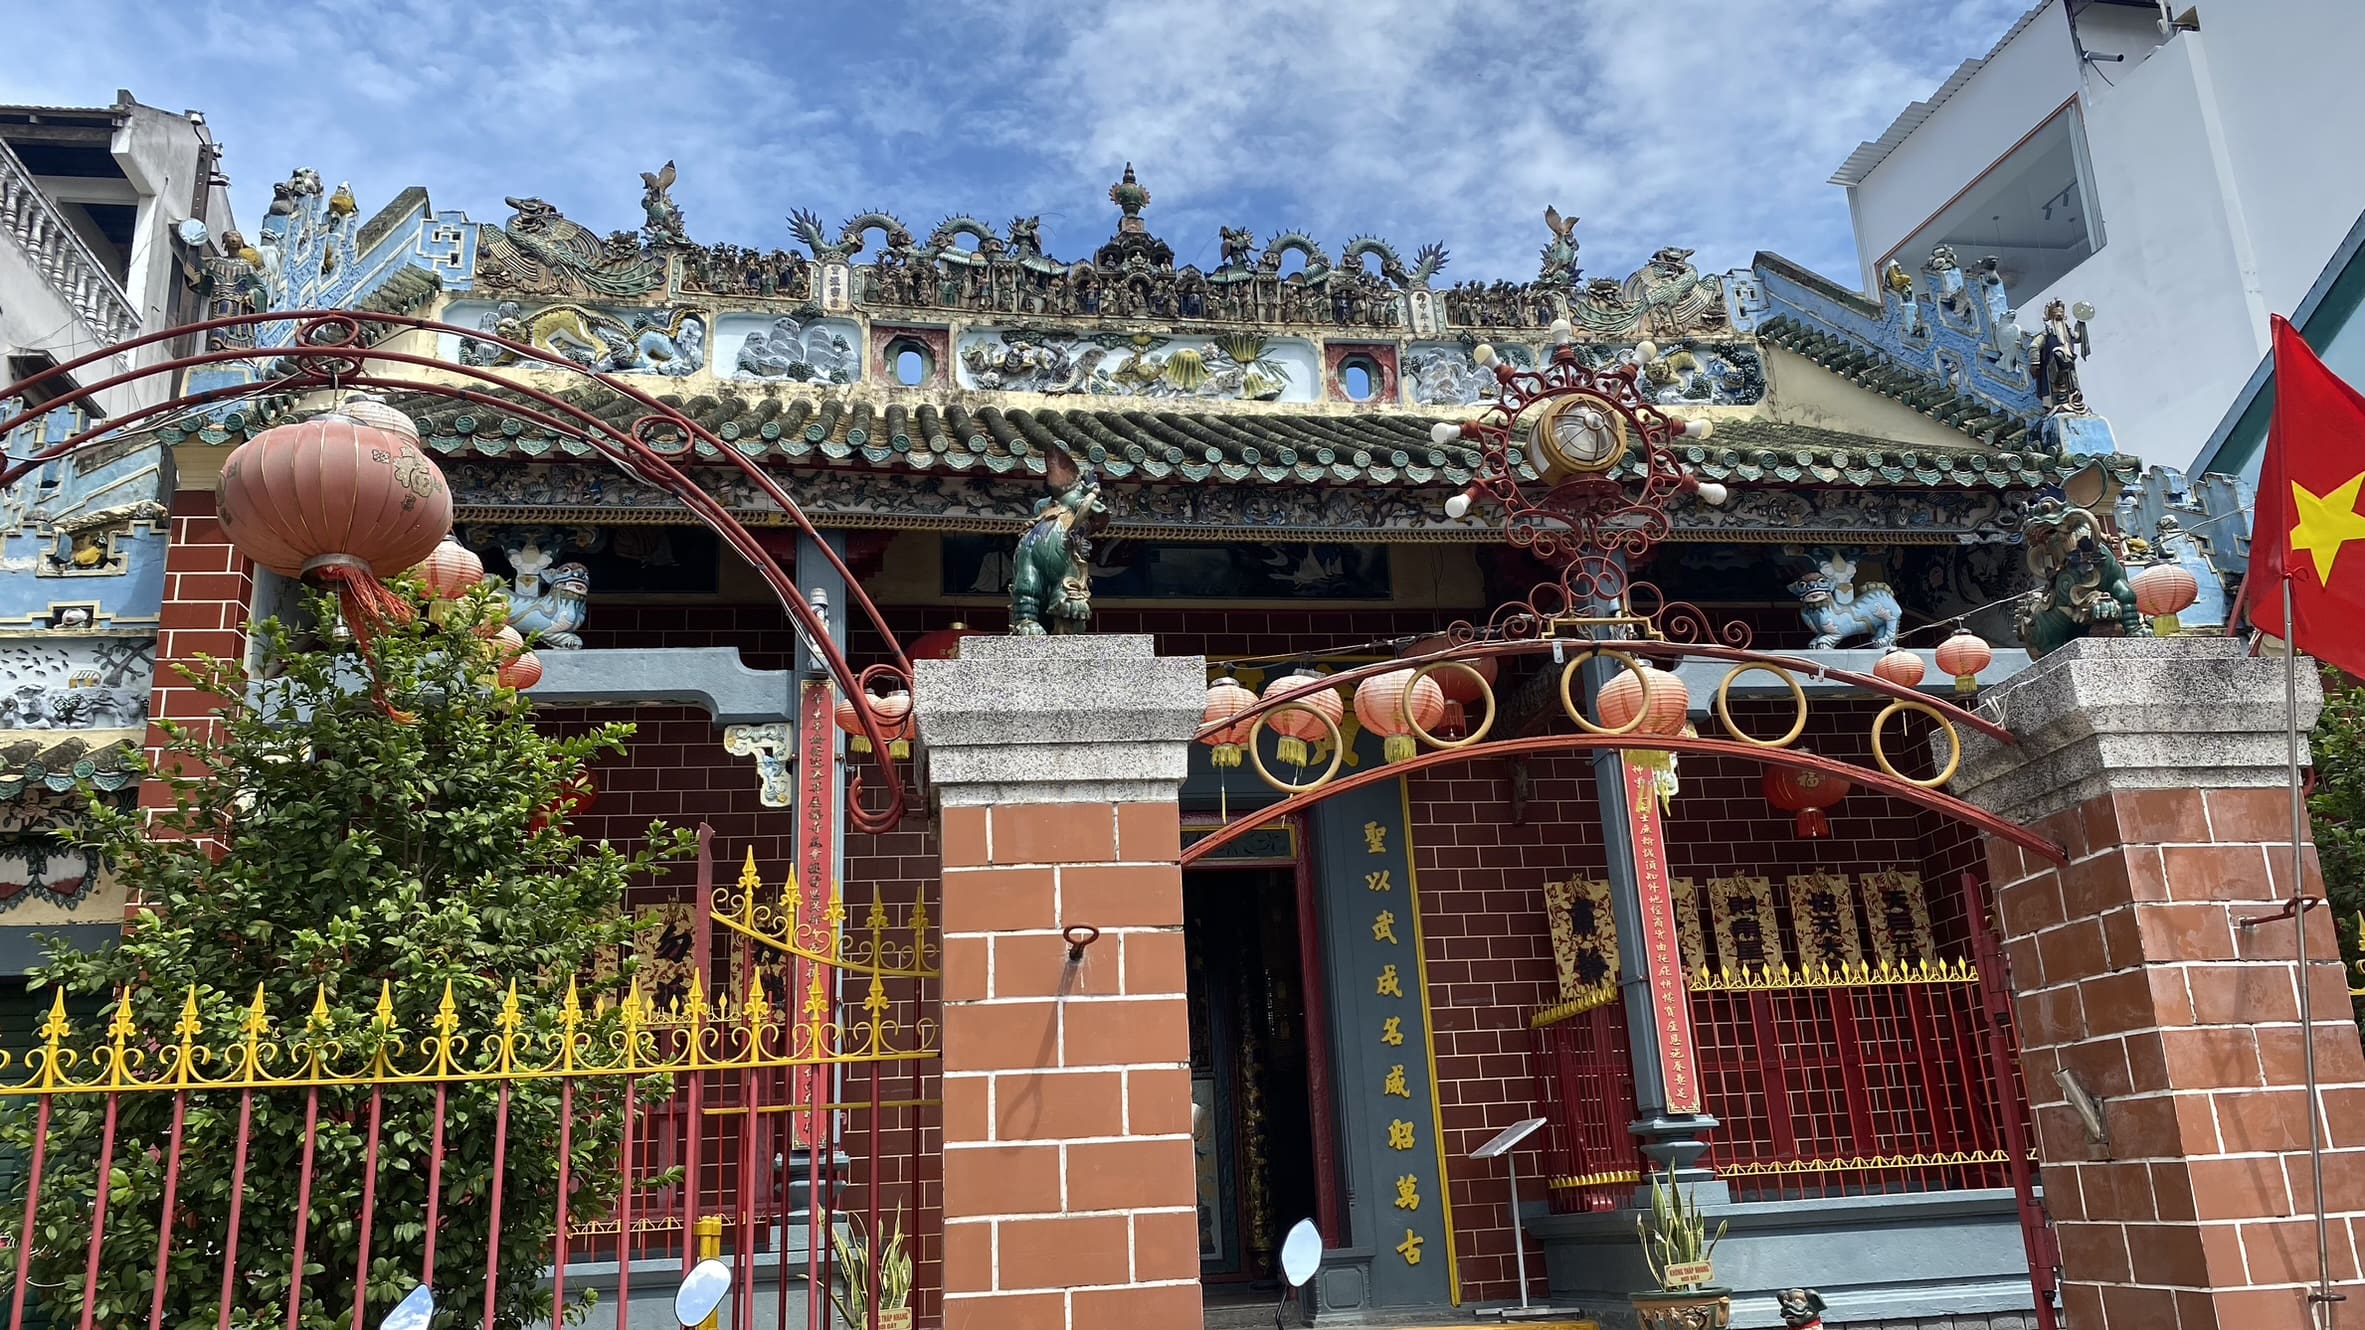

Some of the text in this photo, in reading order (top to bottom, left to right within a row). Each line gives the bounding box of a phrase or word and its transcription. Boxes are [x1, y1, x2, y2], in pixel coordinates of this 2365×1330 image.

[1364, 821, 1425, 1266] 聖以武成名威昭萬古
